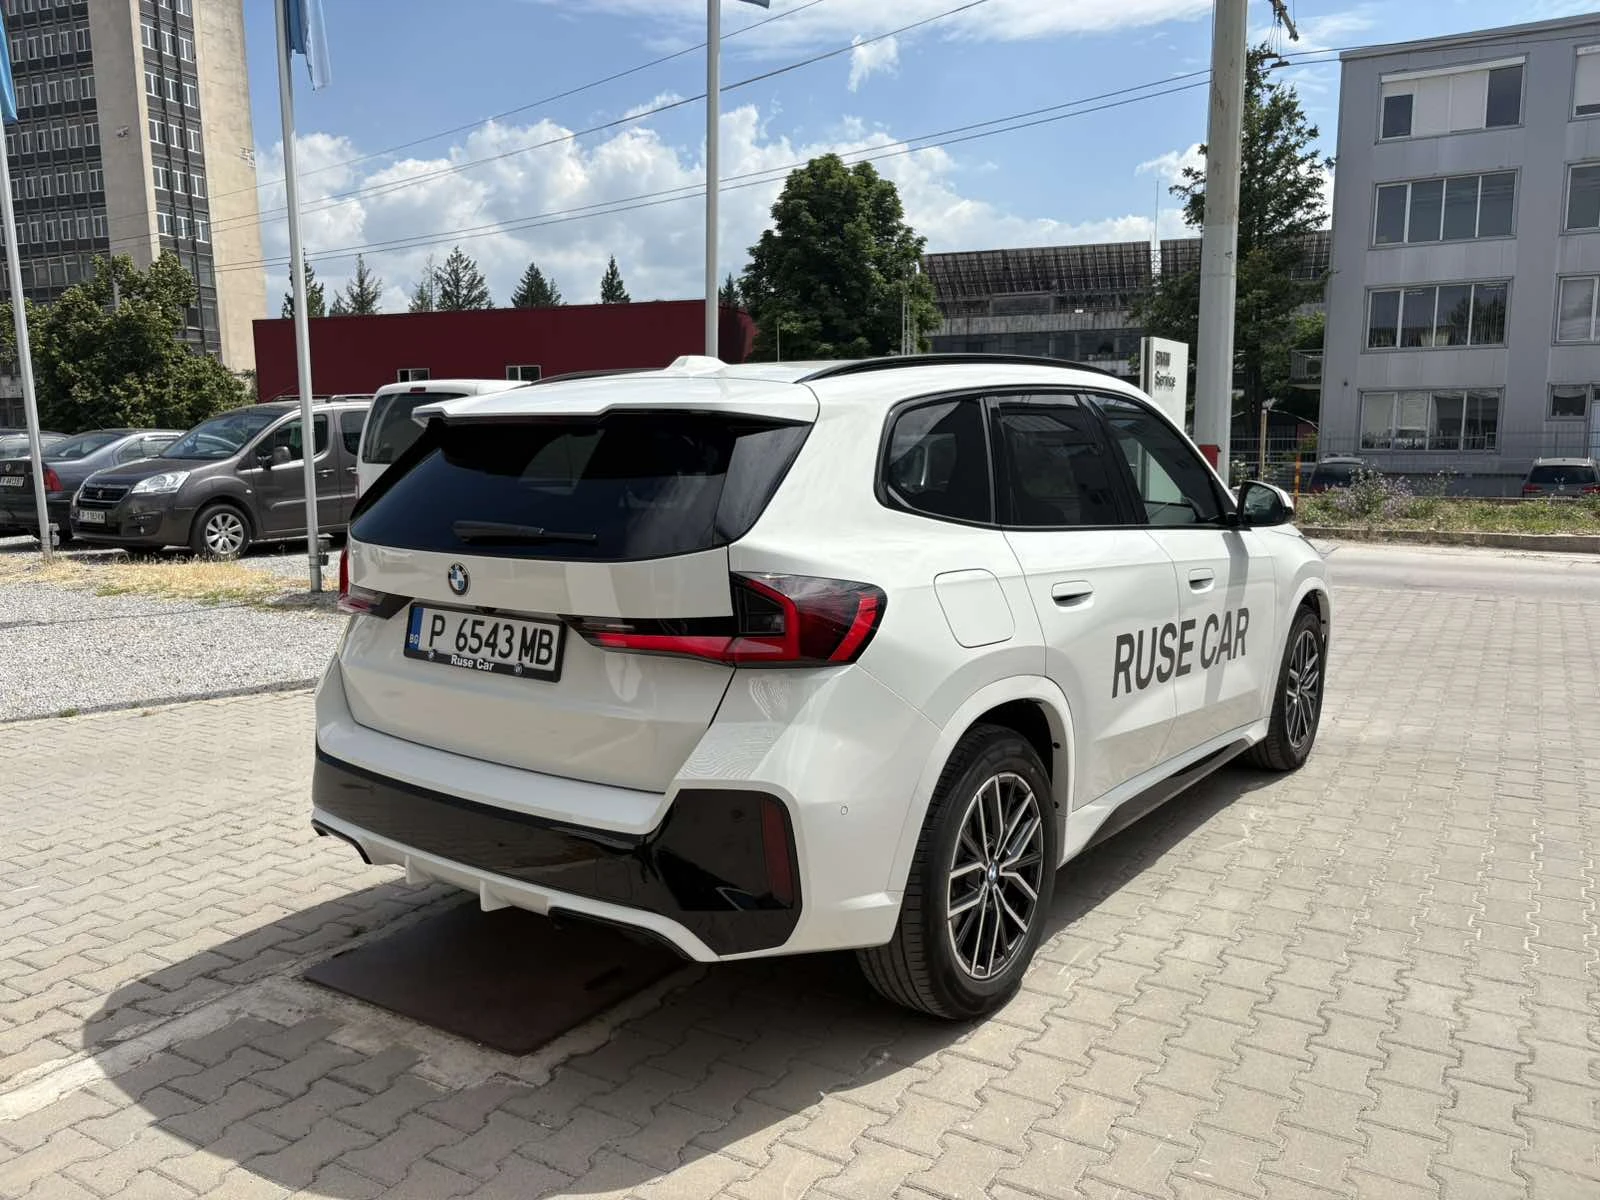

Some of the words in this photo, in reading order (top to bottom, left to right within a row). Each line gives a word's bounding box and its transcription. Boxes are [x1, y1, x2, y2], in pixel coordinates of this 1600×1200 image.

[1155, 350, 1171, 367] BMW
[1155, 370, 1176, 388] Service
[409, 634, 419, 645] BG
[428, 614, 446, 648] P
[455, 618, 515, 659] 6543
[518, 626, 554, 666] MB
[1112, 618, 1196, 699] RUSE
[1200, 607, 1250, 669] CAR
[450, 654, 473, 668] Ruse
[476, 659, 494, 671] Car
